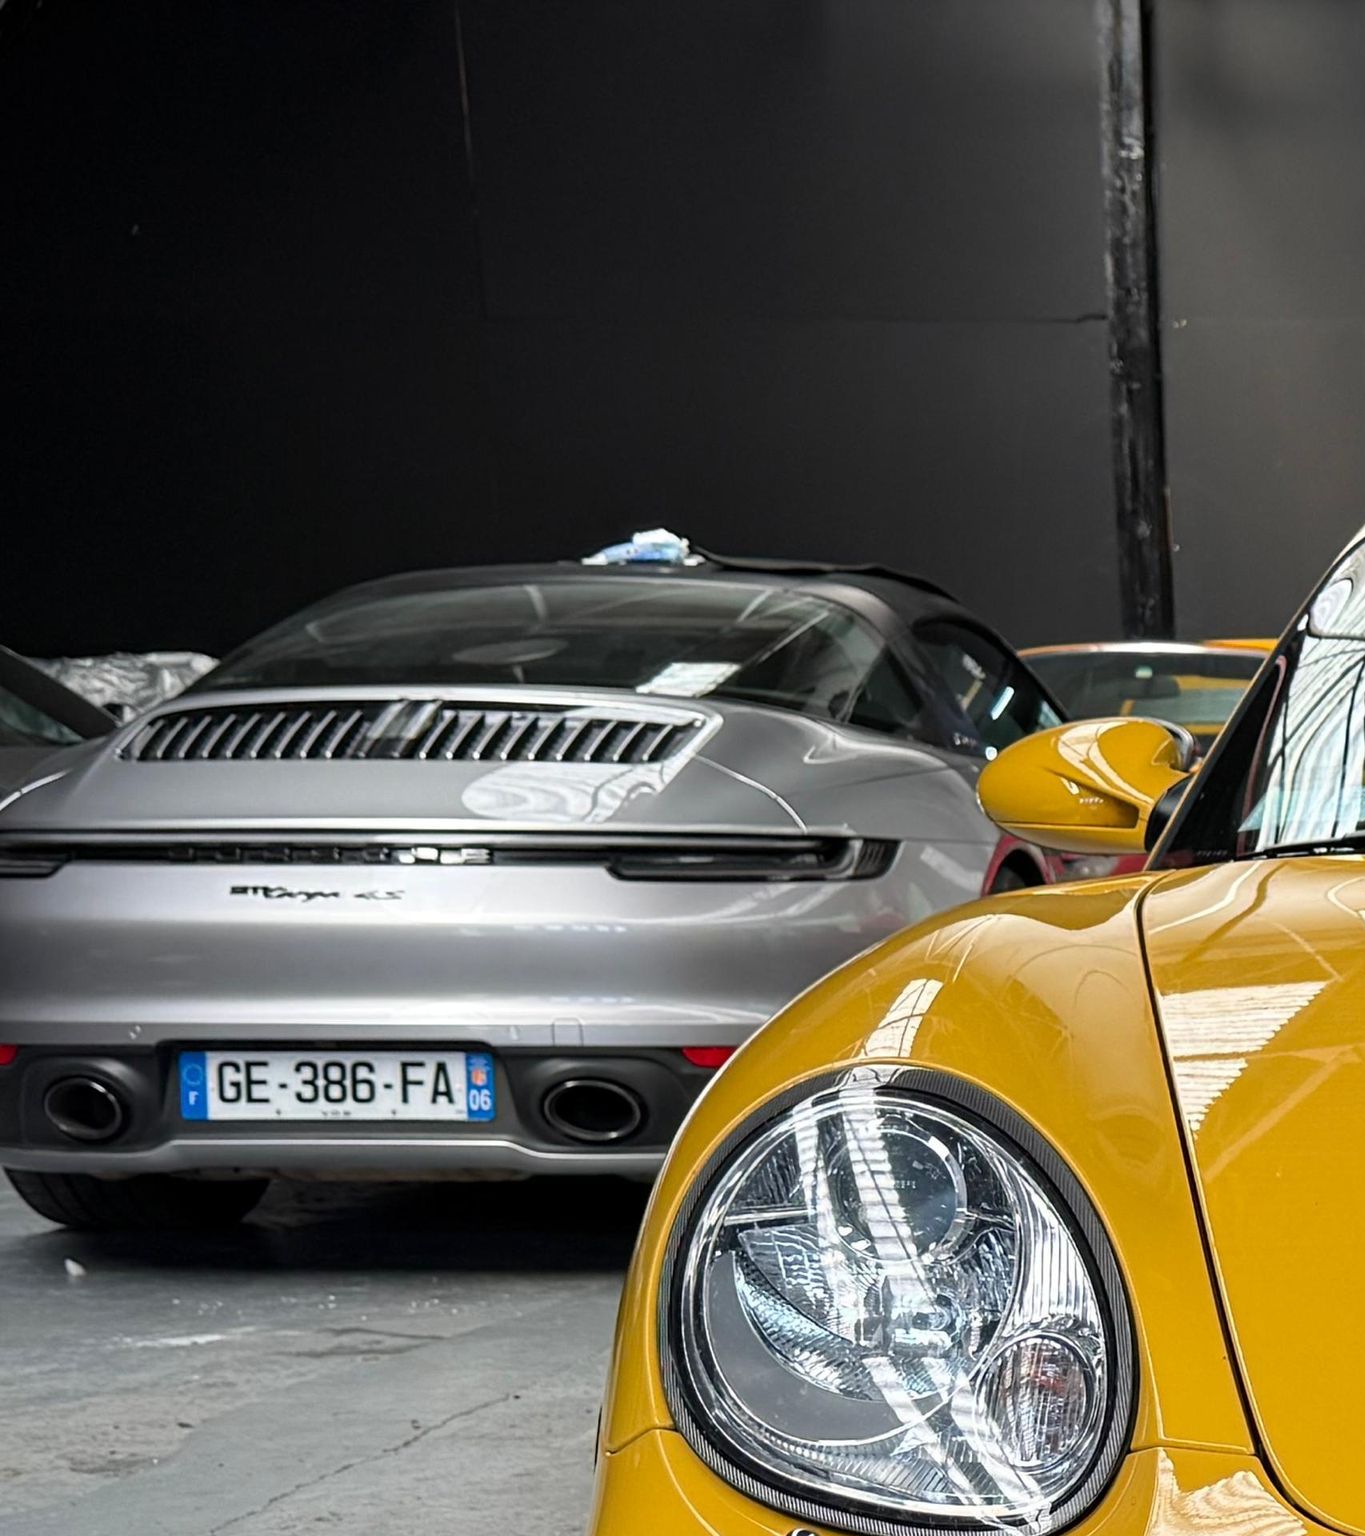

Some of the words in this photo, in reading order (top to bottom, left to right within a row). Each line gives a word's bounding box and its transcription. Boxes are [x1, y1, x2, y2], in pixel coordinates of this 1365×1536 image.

[217, 1061, 455, 1104] GE-386-FA
[188, 1090, 199, 1105] F
[469, 1089, 491, 1111] 06
